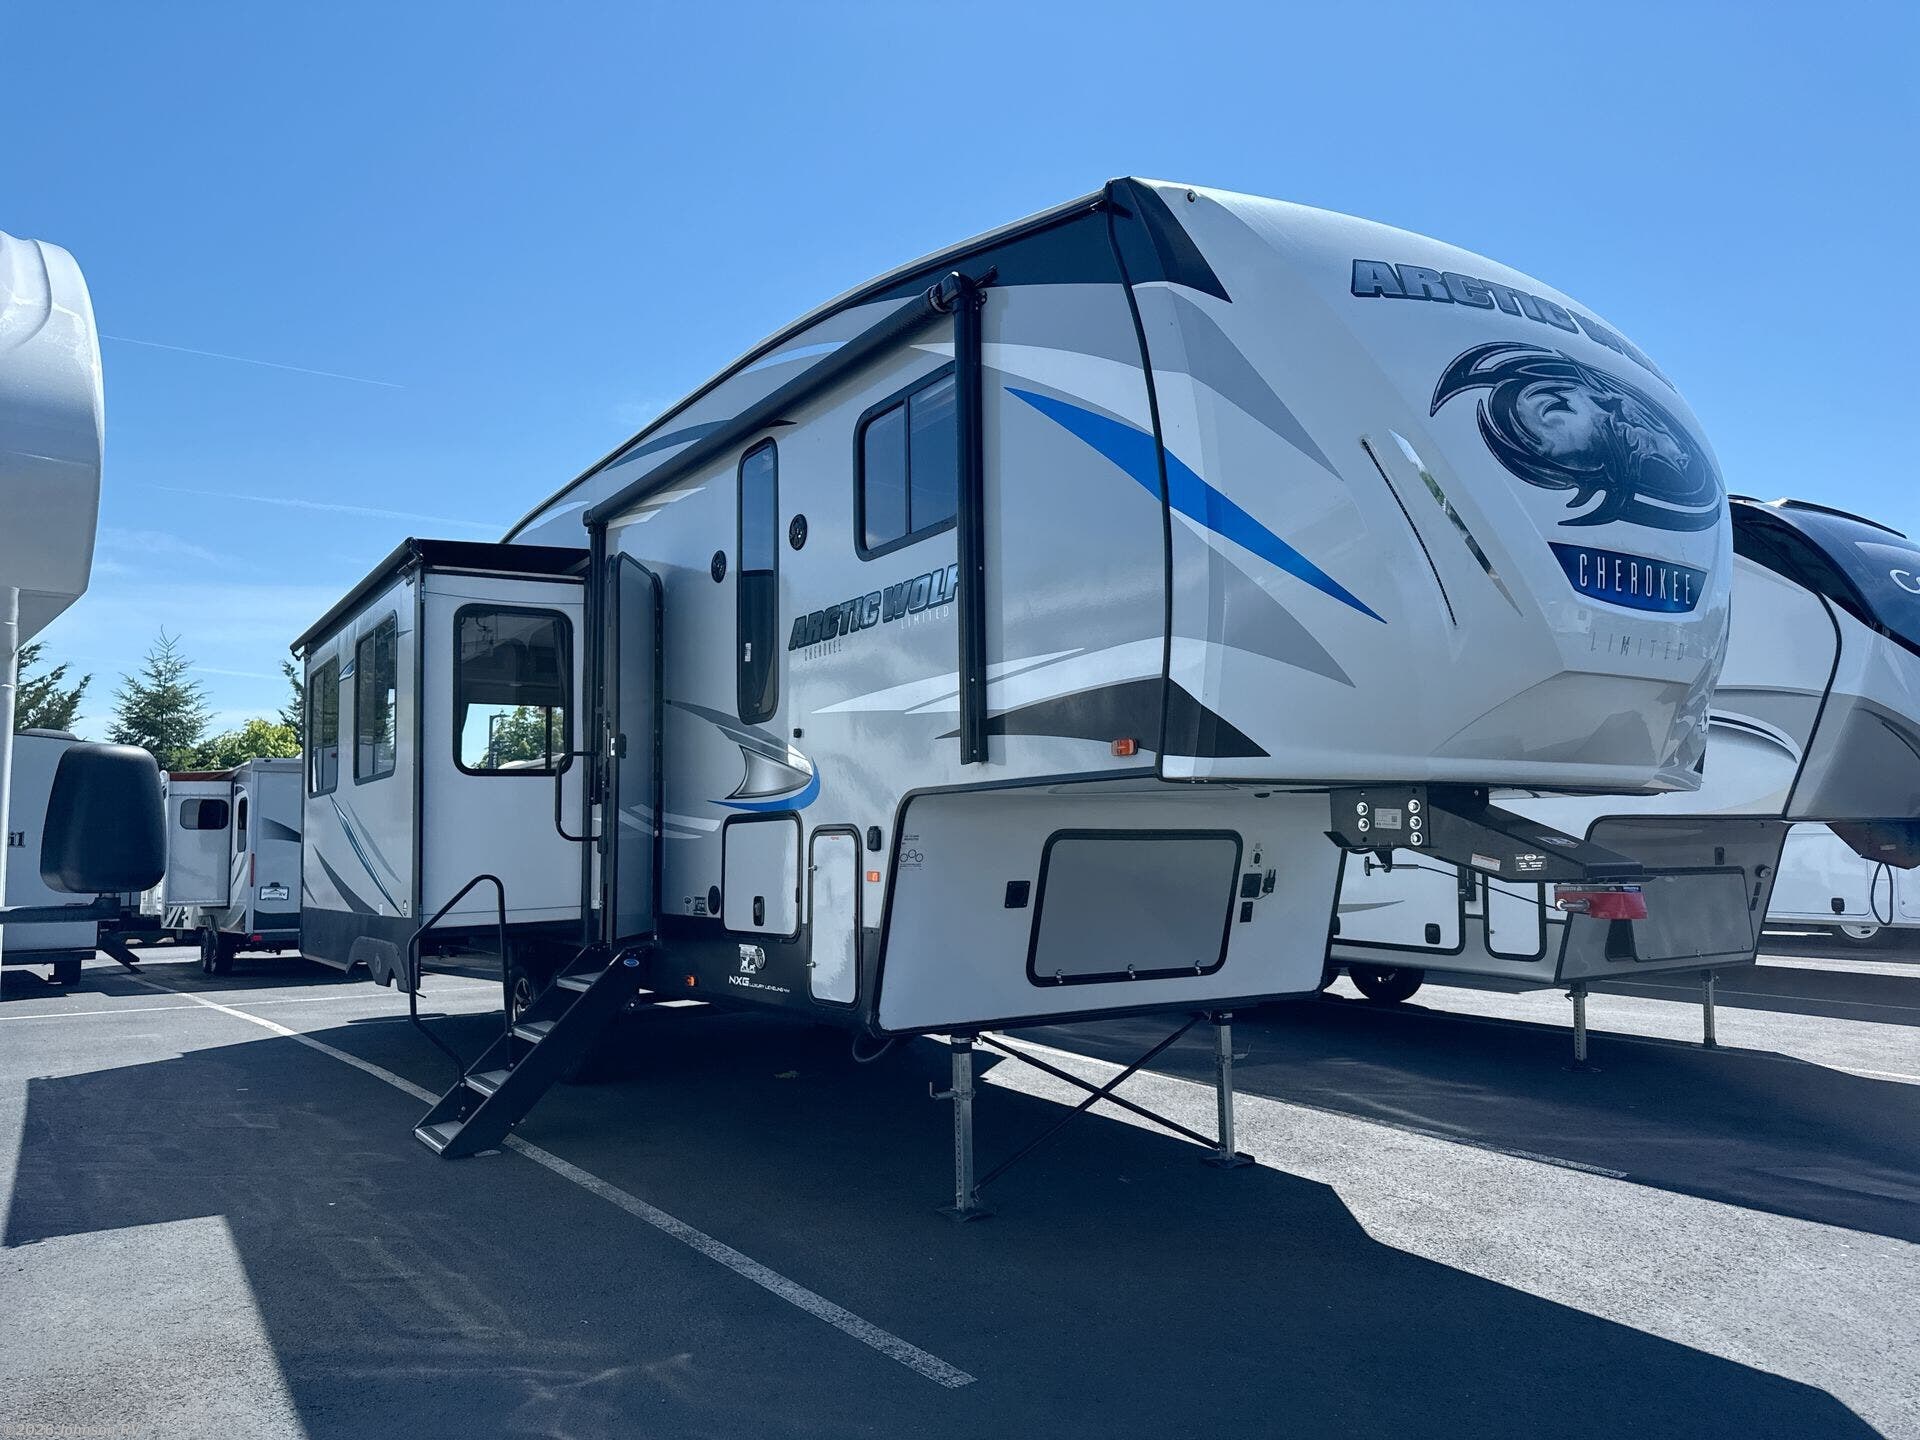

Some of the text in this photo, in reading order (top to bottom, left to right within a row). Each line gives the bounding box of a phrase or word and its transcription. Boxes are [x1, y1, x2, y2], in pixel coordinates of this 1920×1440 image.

[1351, 259, 1579, 335] ARCTIC
[1579, 553, 1692, 604] CHEROKEE
[788, 590, 881, 651] ARCTIC
[901, 605, 949, 630] LIMITED
[804, 638, 842, 661] CHEROKEE
[1590, 631, 1685, 661] LIMITED
[729, 975, 750, 987] NXG
